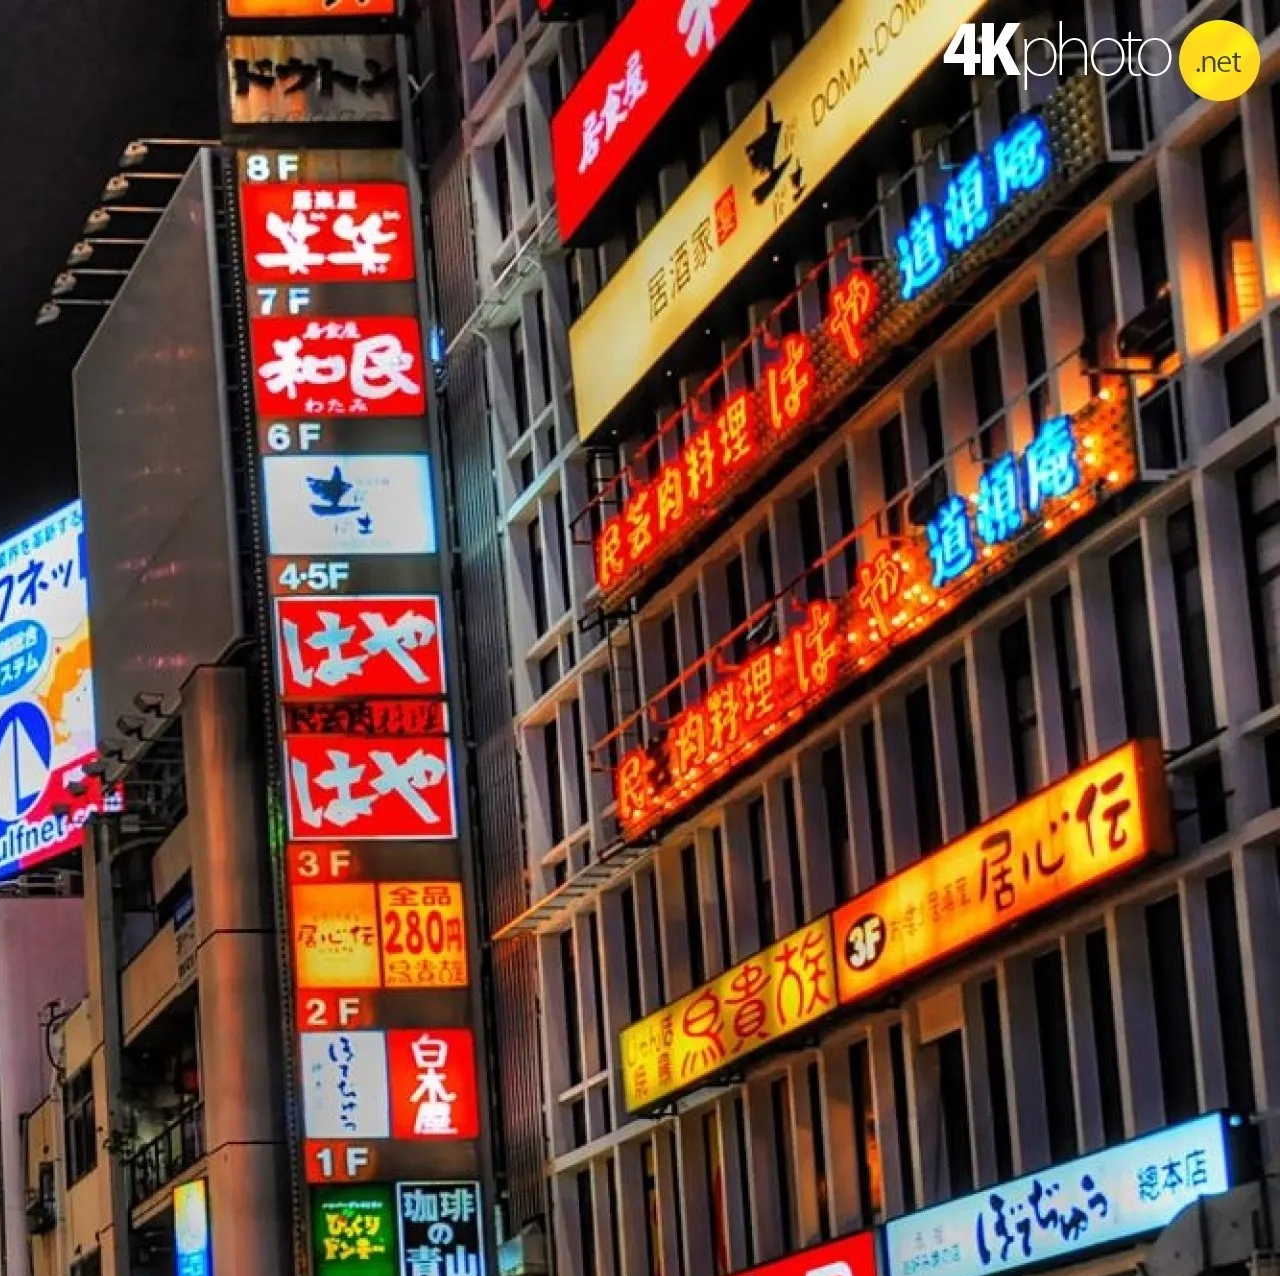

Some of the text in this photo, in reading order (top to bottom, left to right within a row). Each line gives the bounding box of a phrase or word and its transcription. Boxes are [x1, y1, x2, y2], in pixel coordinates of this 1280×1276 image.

[258, 333, 421, 400] 和民
[281, 609, 438, 688] はや
[290, 749, 448, 829] はや
[389, 886, 451, 907] 全品
[384, 909, 463, 955] 280円
[849, 915, 882, 968] 3F
[409, 1032, 459, 1136] 白木屋
[1138, 1148, 1208, 1201] 総本店
[402, 1188, 475, 1223] 珈琲
[427, 1222, 455, 1246] の
